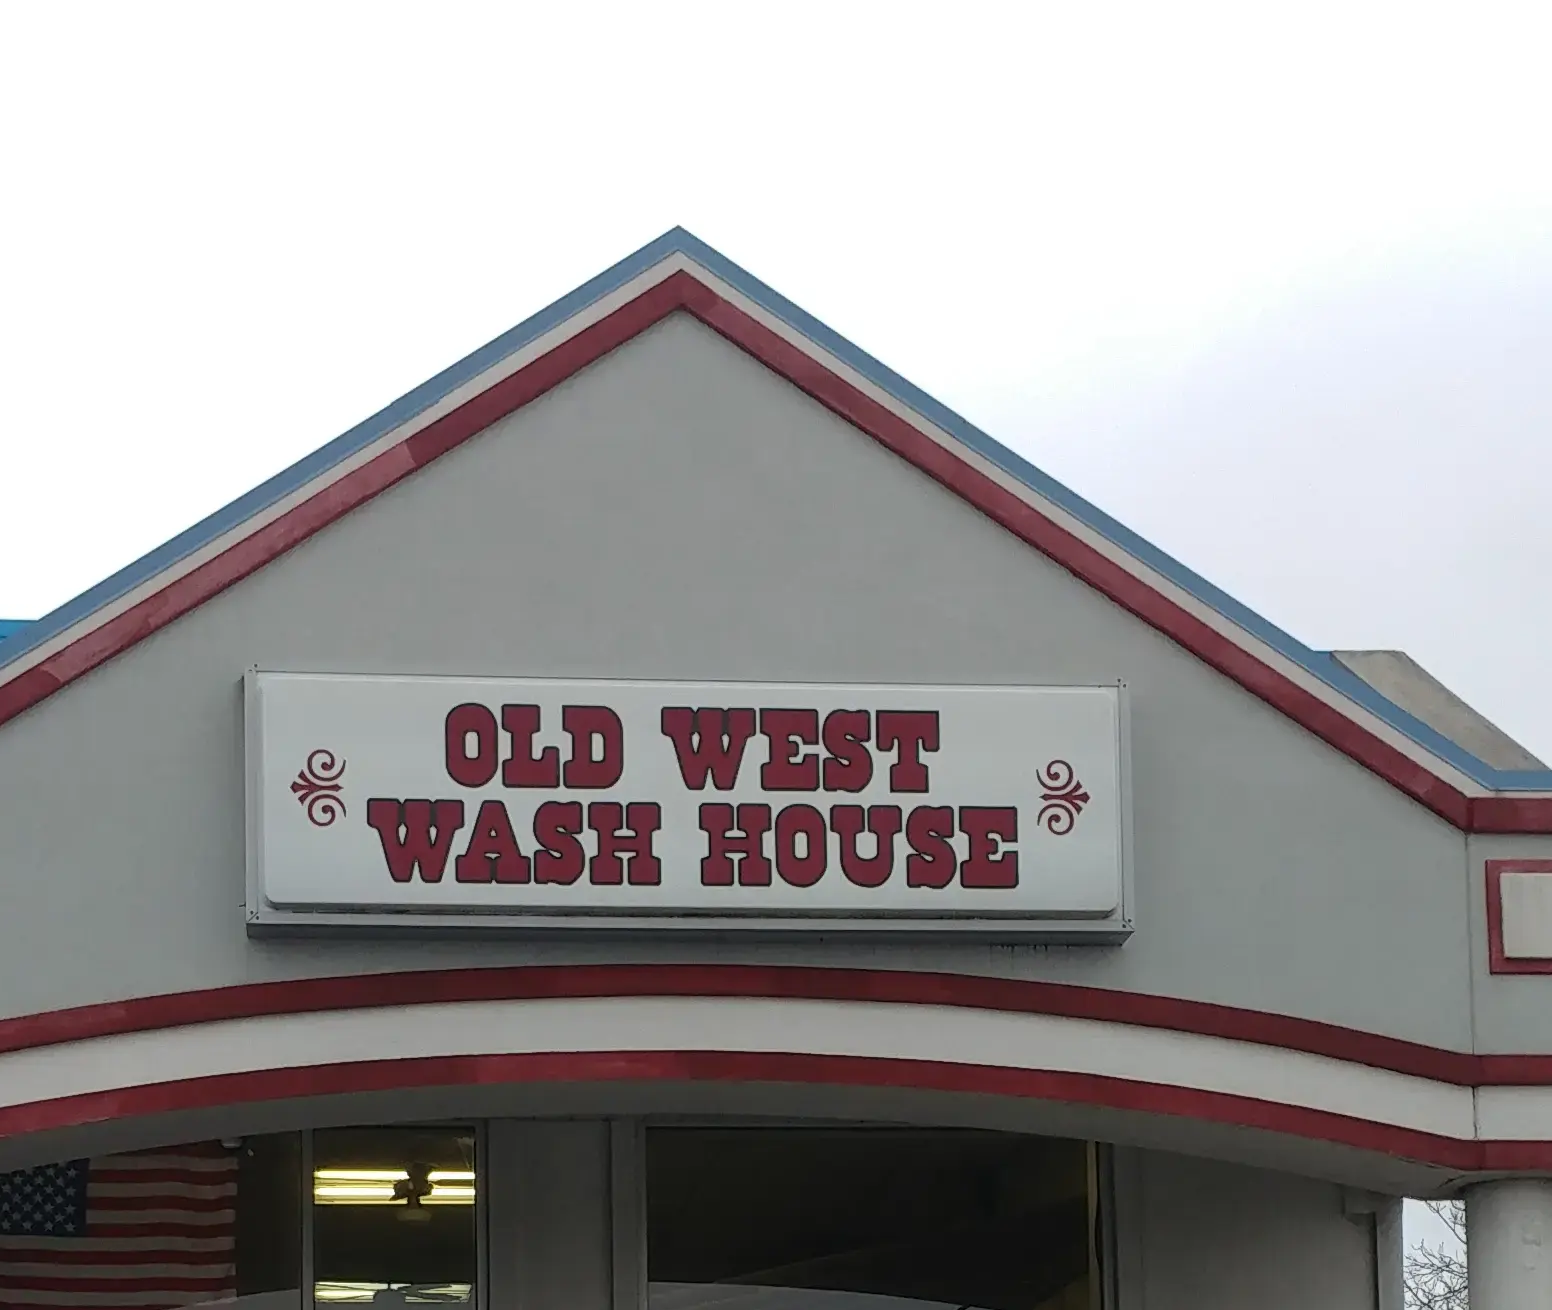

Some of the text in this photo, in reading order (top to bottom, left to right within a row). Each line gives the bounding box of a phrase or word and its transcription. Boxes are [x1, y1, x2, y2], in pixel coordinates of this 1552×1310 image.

[446, 703, 941, 794] OLD WEST
[367, 799, 1019, 890] WASH HOUSE
